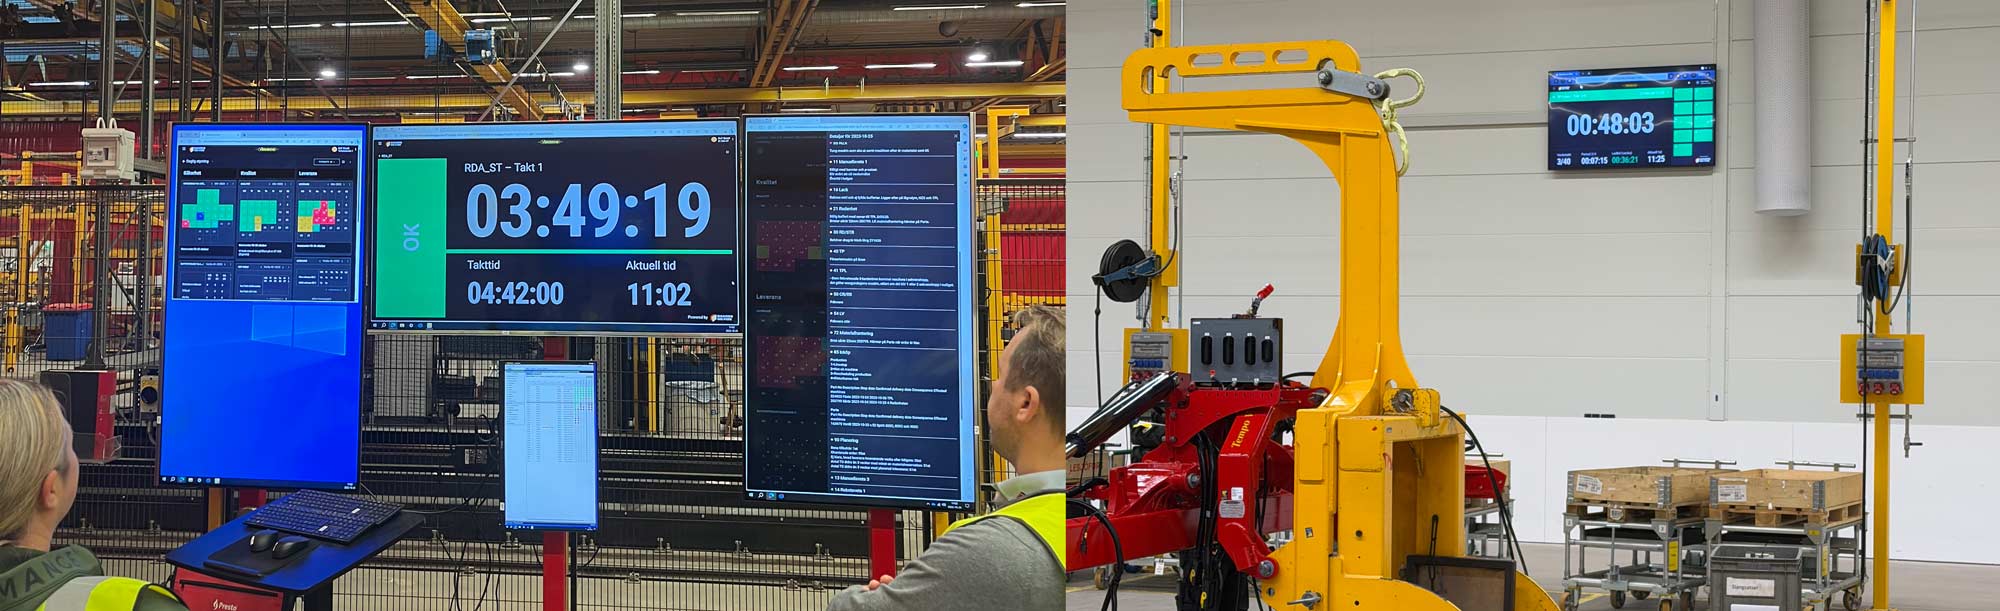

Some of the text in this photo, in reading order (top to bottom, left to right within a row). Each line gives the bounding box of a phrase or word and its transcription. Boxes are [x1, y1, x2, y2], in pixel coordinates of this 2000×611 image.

[1567, 112, 1655, 136] 00:48:03
[1556, 157, 1571, 166] 3/40
[1581, 157, 1608, 165] 00:07:15
[1611, 156, 1638, 164] 00:36:21
[1648, 155, 1666, 163] 11:25
[464, 163, 502, 174] RDA_ST
[514, 162, 535, 172] Takt
[538, 163, 543, 172] 1
[467, 182, 711, 238] 03:49:19
[403, 223, 420, 251] OK
[467, 259, 500, 270] Takttid
[626, 260, 676, 271] Aktuell tid
[468, 281, 564, 305] 04:42:00
[627, 282, 691, 306] 11:02
[1231, 420, 1251, 448] Tempo
[218, 601, 238, 611] Presto
